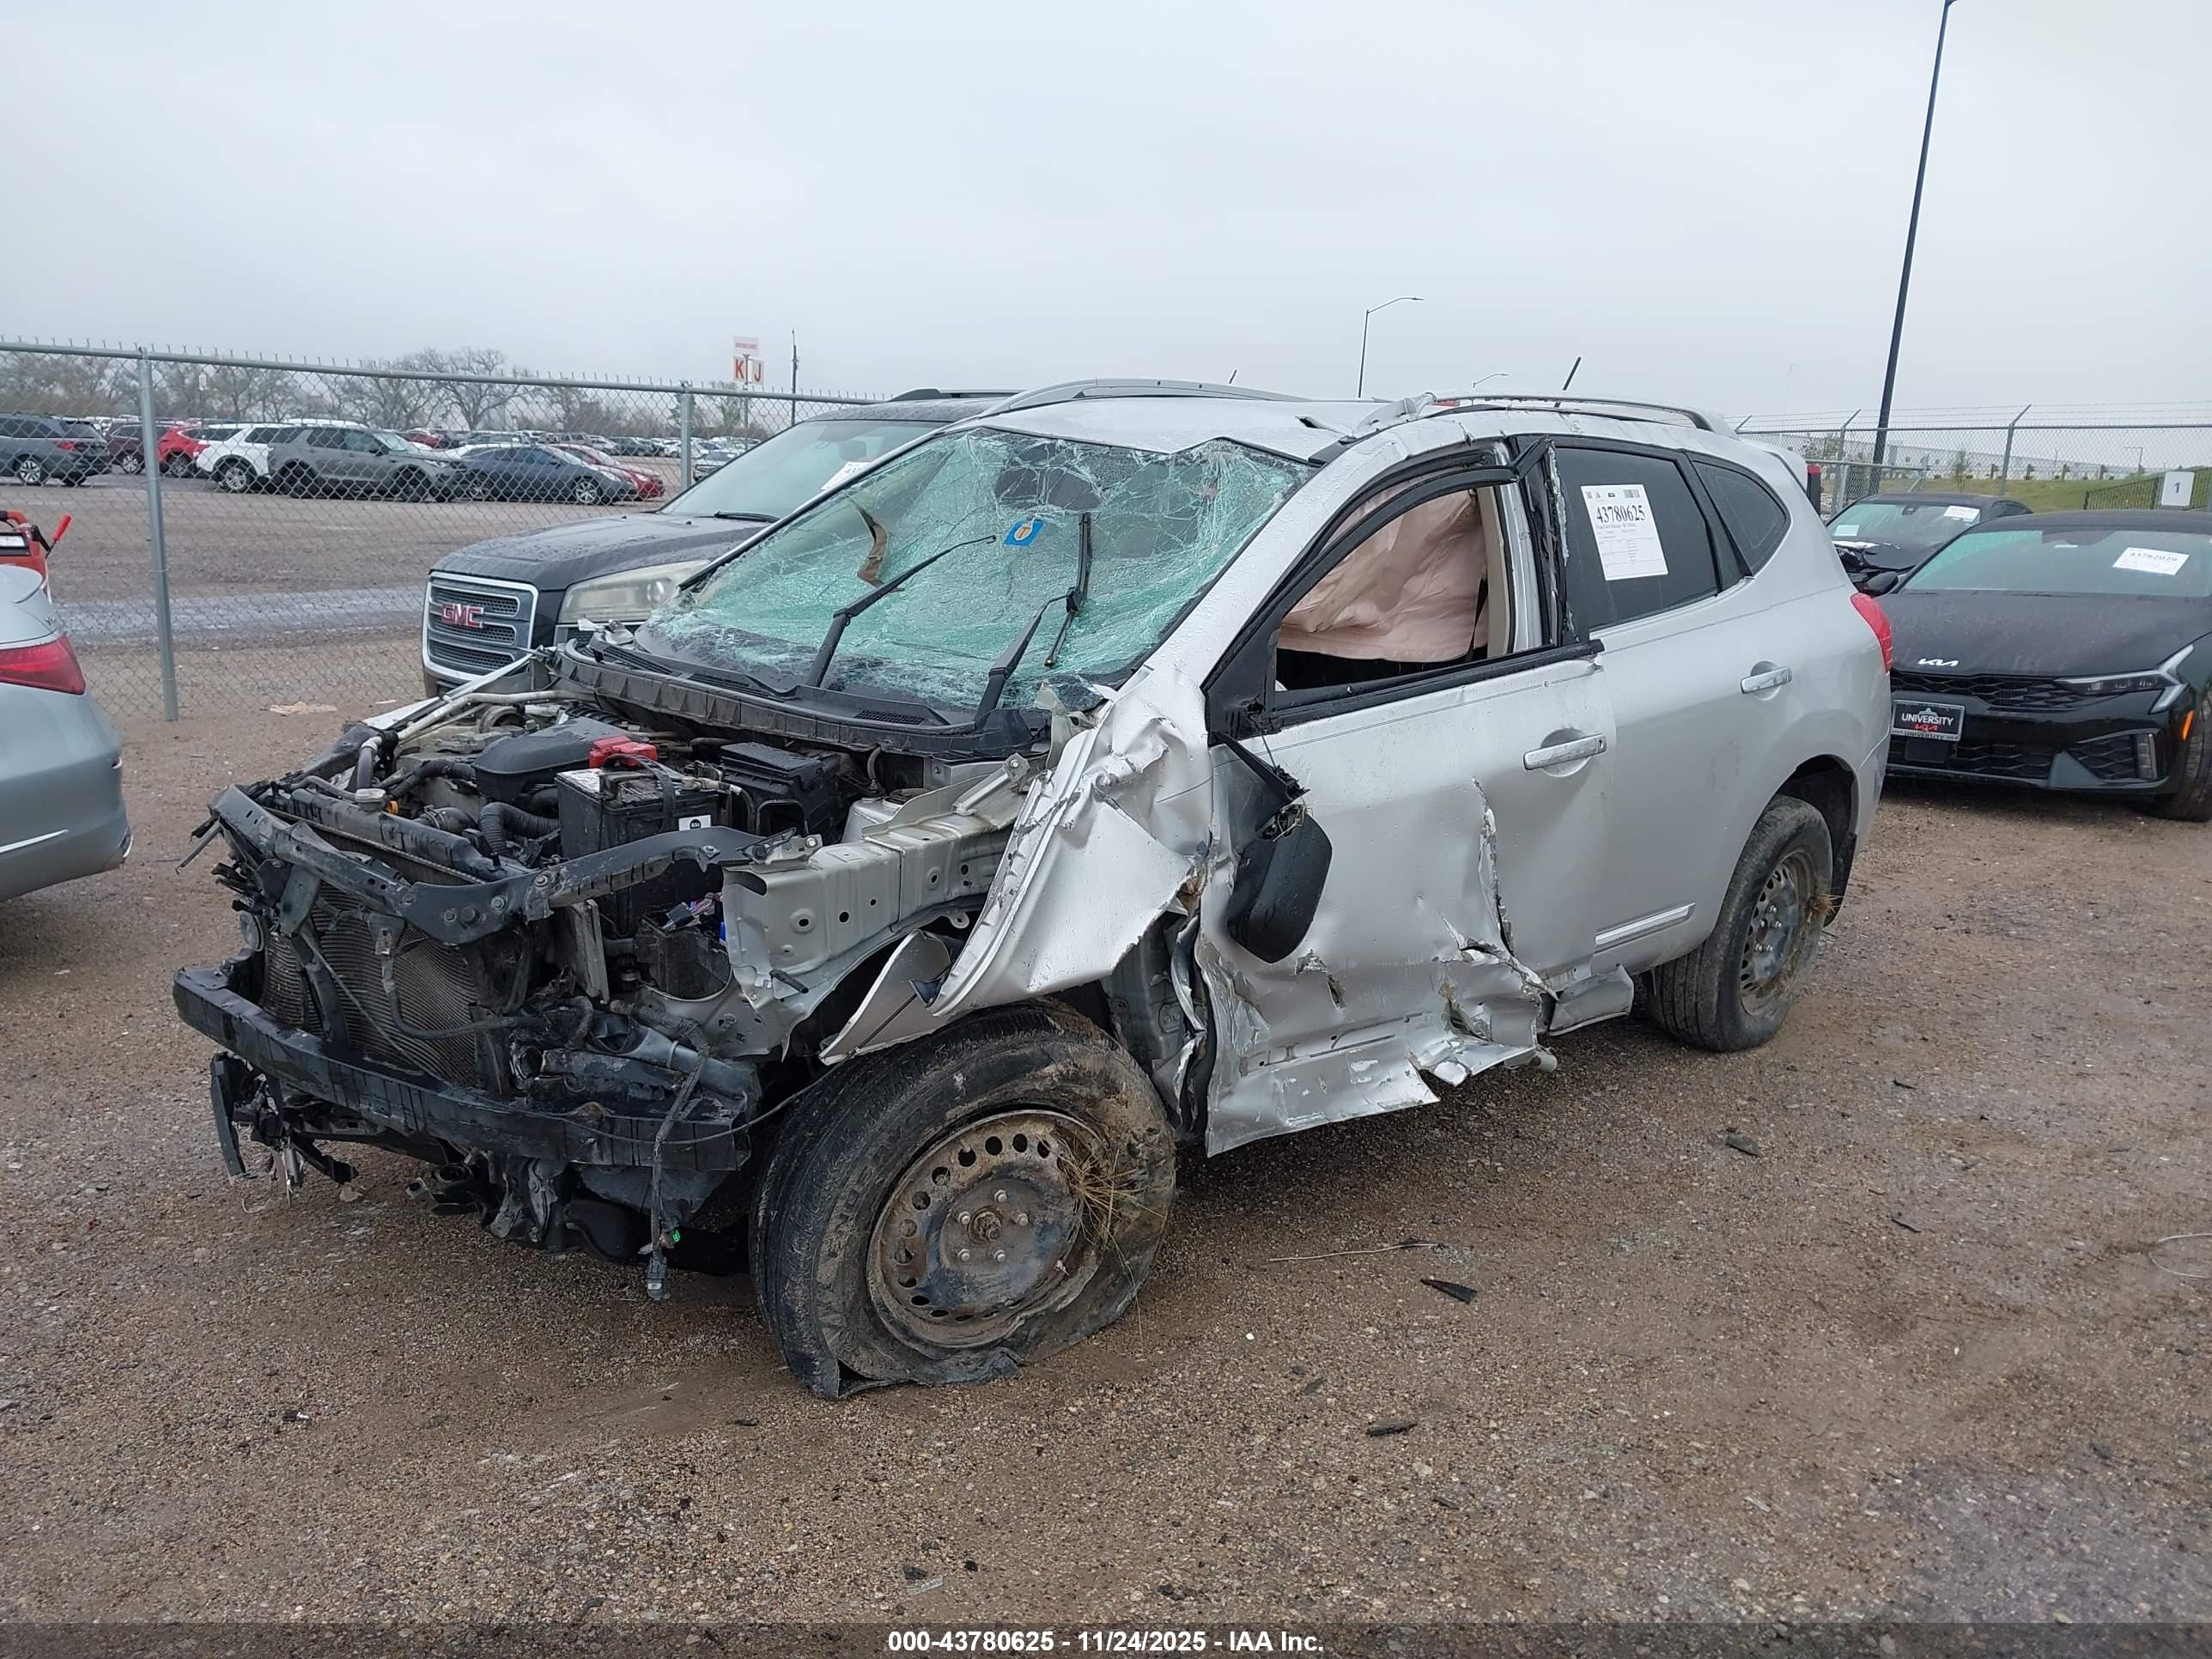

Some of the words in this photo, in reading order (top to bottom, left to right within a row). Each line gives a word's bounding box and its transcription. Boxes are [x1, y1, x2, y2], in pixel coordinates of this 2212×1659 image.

[735, 359, 744, 379] K
[754, 363, 762, 382] J
[2174, 482, 2180, 494] 1
[1597, 505, 1645, 523] 43780625
[441, 603, 483, 628] GMC
[1901, 713, 1954, 726] UNIVERSITY
